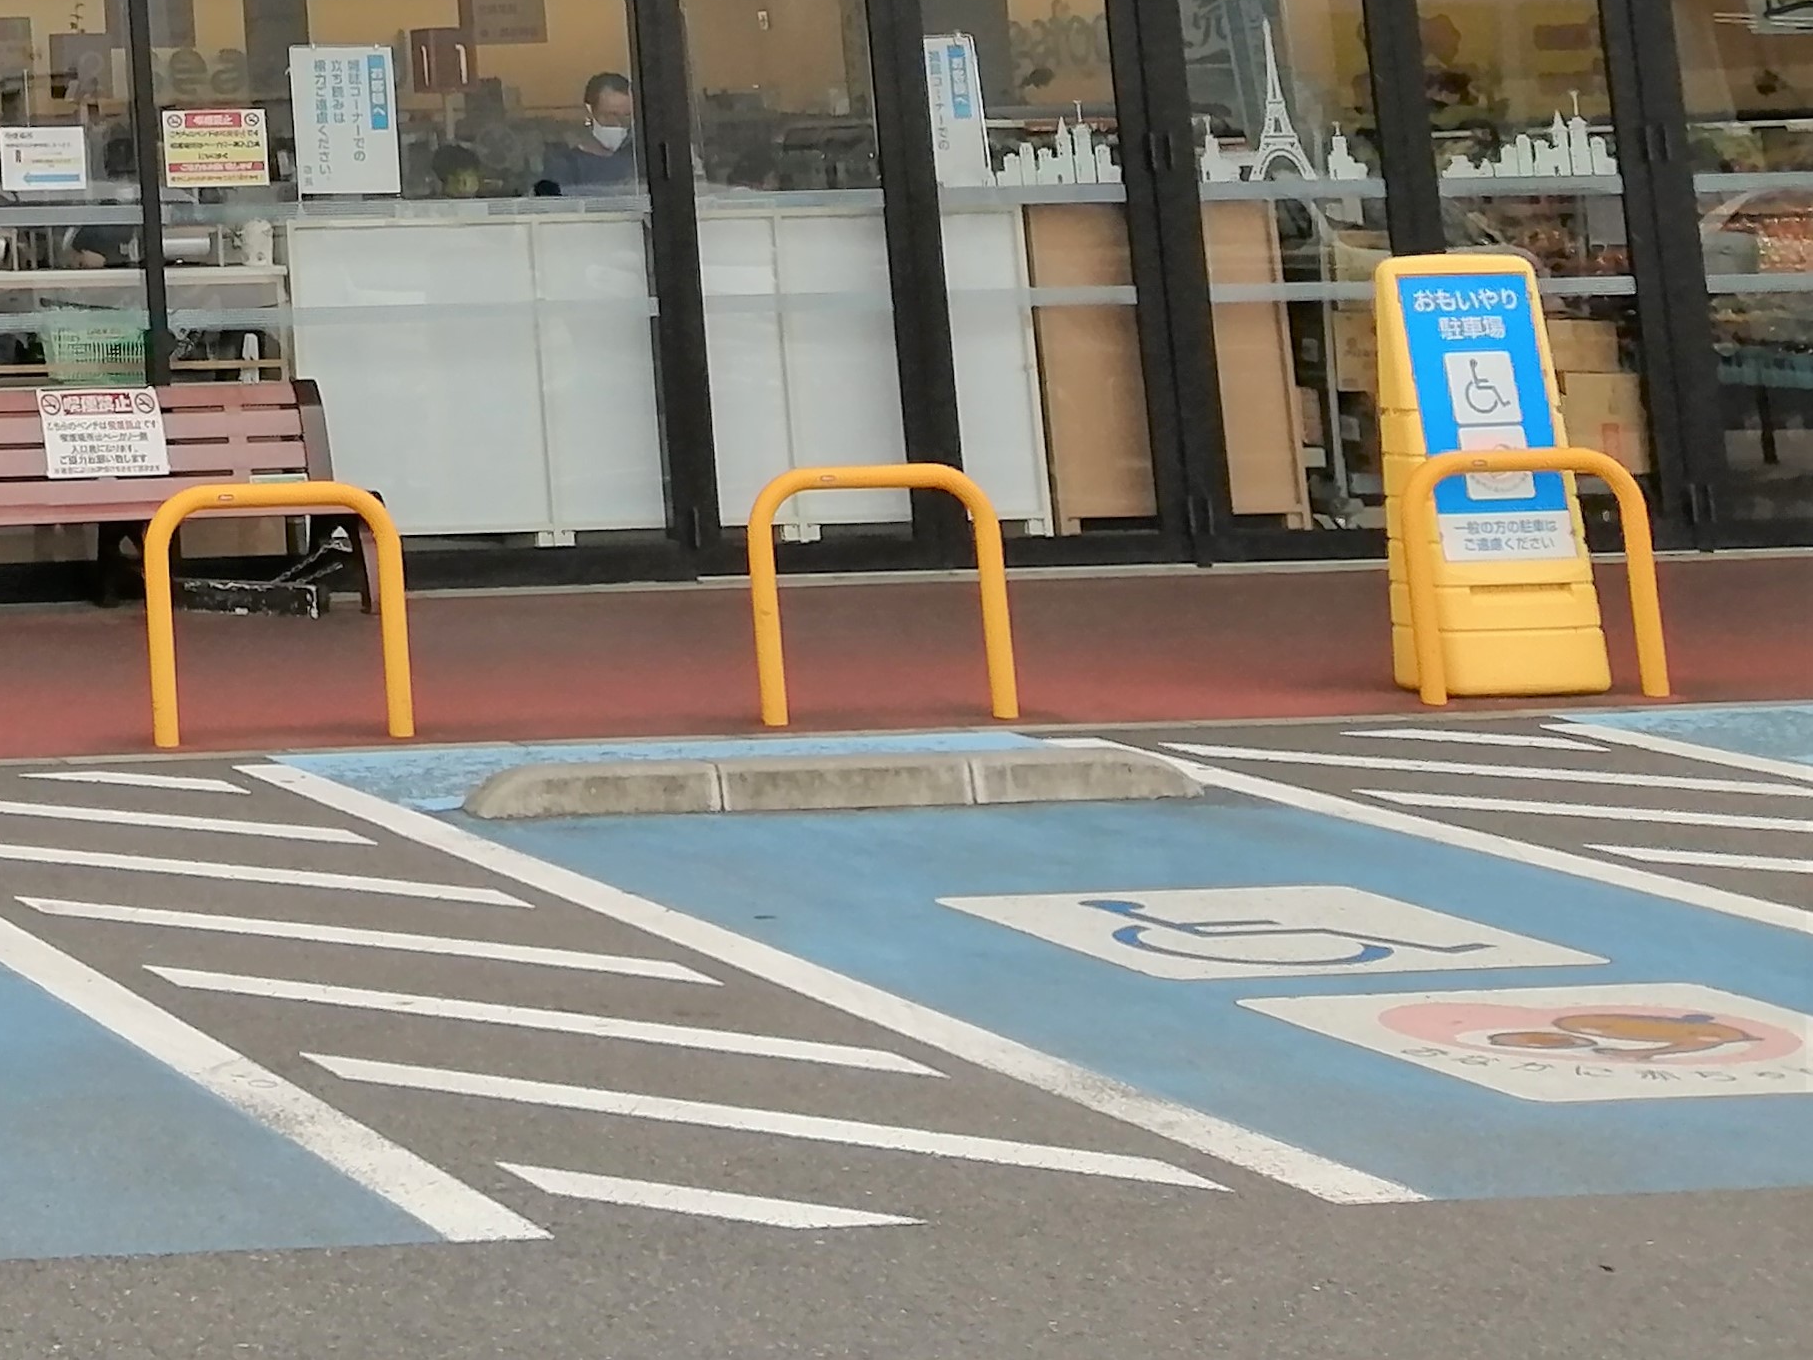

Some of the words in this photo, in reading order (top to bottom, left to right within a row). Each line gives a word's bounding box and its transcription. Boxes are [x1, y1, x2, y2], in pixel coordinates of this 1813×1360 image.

[331, 60, 346, 124] 立ち読みは
[1413, 287, 1518, 313] おもいやり
[1438, 315, 1507, 341] 駐車場
[1454, 519, 1558, 535] 一般の方の駐車は
[1463, 537, 1556, 551] ご遠慮ください
